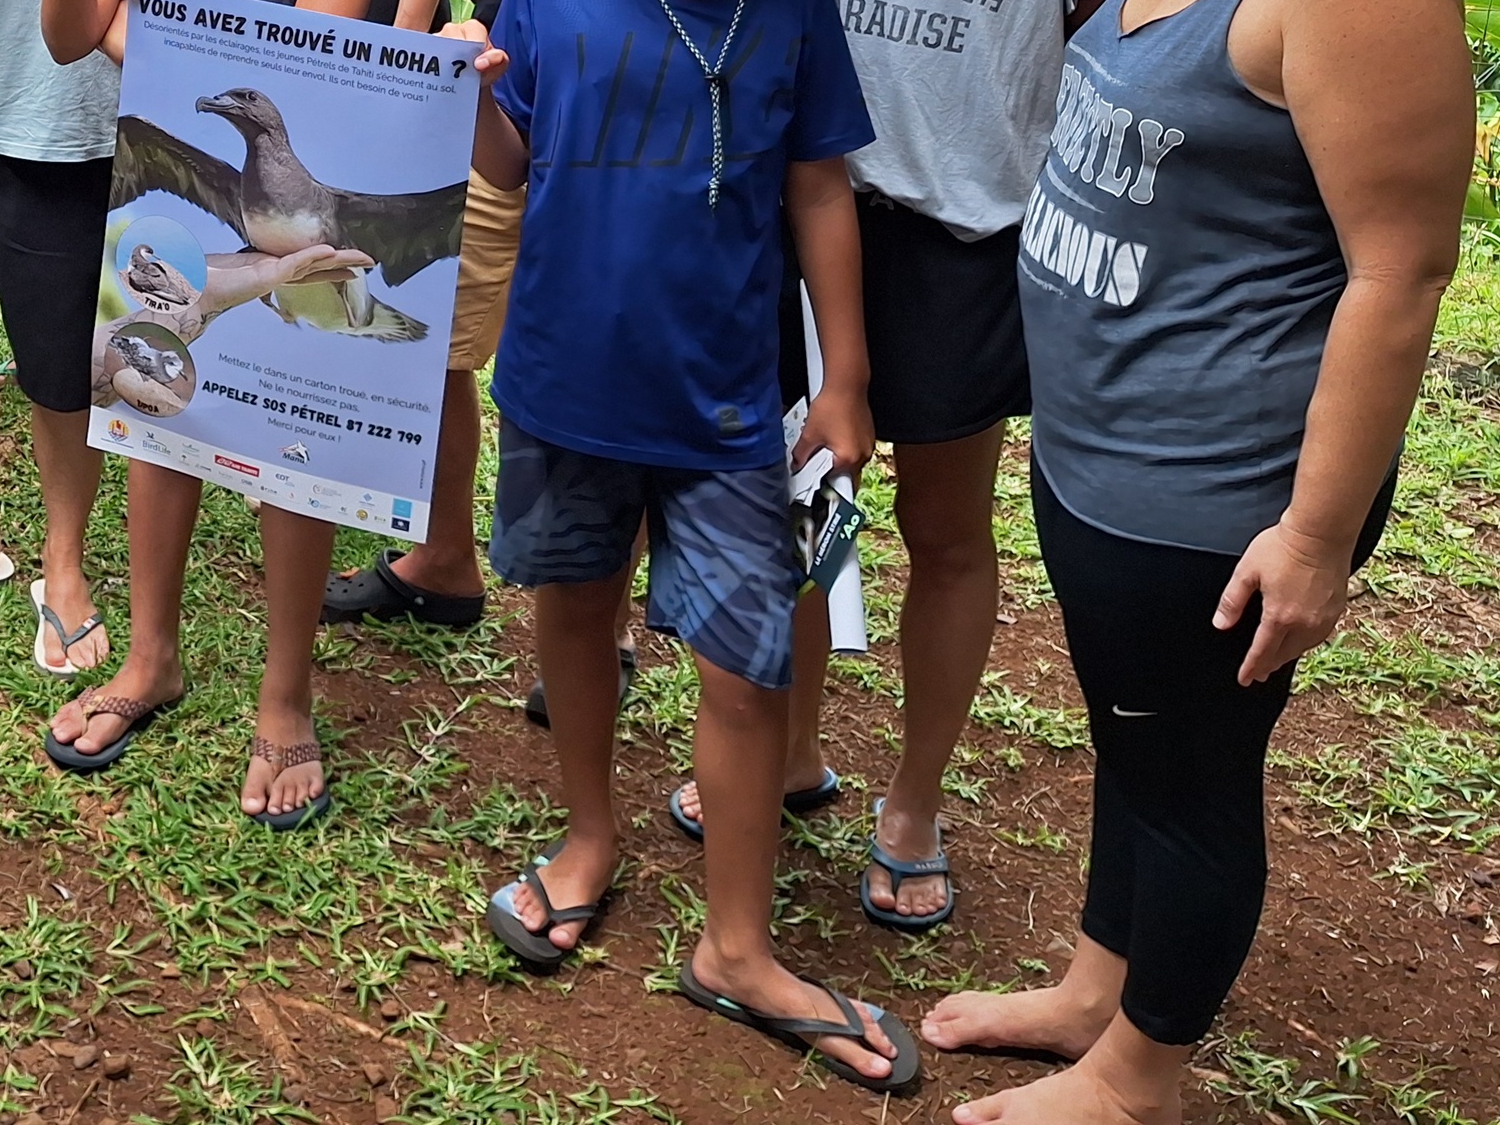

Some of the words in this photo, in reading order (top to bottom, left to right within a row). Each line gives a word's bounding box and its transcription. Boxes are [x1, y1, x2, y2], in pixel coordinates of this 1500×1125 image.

[143, 20, 190, 38] Désorientés
[190, 32, 205, 42] par
[205, 34, 217, 44] les
[263, 47, 276, 58] les
[276, 51, 305, 65] jeunes
[306, 56, 336, 71] Pétrels
[337, 63, 350, 74] de
[351, 66, 375, 79] Tahiti
[426, 82, 439, 92] au
[163, 36, 206, 55] incapables
[207, 47, 219, 57] de
[219, 51, 260, 67] reprendre
[260, 61, 283, 73] seuls
[283, 64, 301, 77] leur
[328, 75, 339, 85] Ils
[340, 77, 355, 88] ont
[356, 80, 387, 95] besoin
[387, 88, 400, 98] de
[401, 92, 424, 103] vous
[193, 8, 248, 36] AVEZ
[254, 20, 337, 55] TROUVÉ
[342, 38, 373, 63] UN
[378, 46, 441, 77] NOHA
[451, 59, 467, 79] ?
[218, 352, 251, 370] Mettez
[252, 362, 262, 373] le
[263, 366, 288, 380] dans
[289, 374, 303, 384] un
[304, 378, 337, 393] carton
[370, 394, 385, 403] en
[258, 378, 273, 390] Ne
[275, 383, 285, 394] le
[286, 387, 337, 407] nourrissez
[201, 379, 259, 406] APPELEZ
[262, 397, 287, 414] SOS
[290, 404, 342, 428] PÉTREL
[346, 418, 364, 433] 87
[367, 423, 393, 440] 222
[396, 430, 423, 446] 799
[267, 416, 294, 431] Merci
[294, 425, 317, 437] pour
[318, 431, 336, 442] eux
